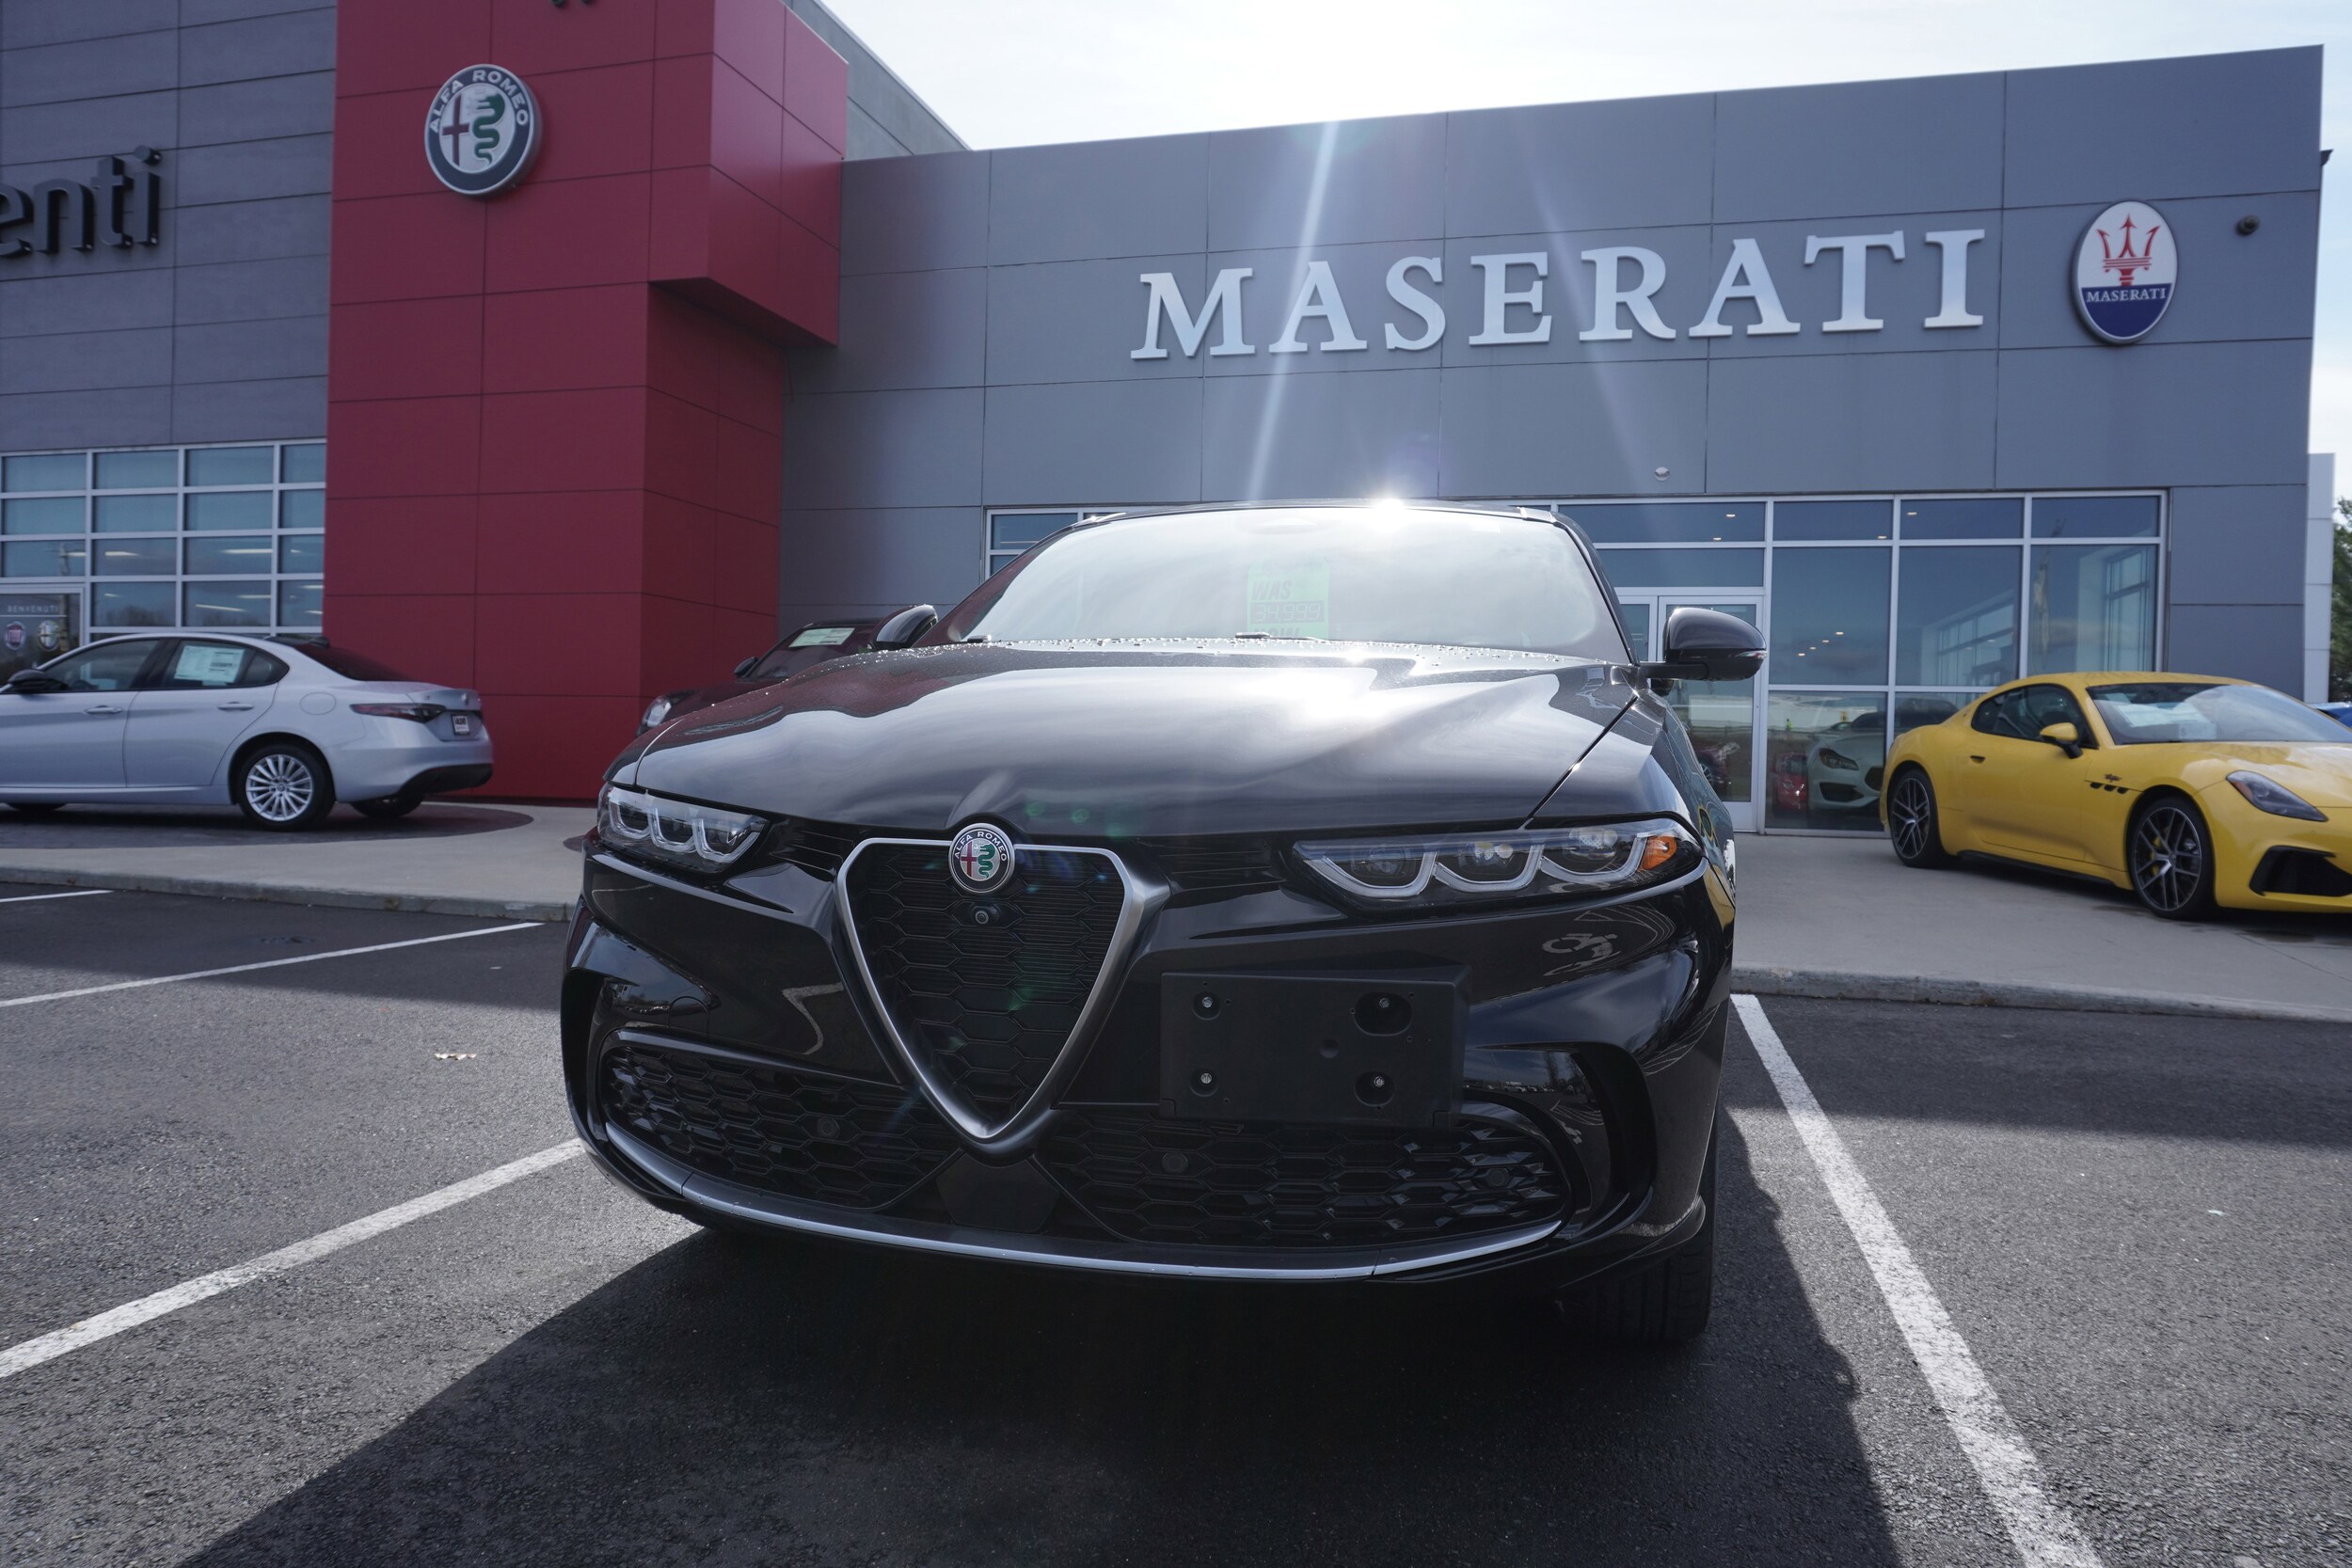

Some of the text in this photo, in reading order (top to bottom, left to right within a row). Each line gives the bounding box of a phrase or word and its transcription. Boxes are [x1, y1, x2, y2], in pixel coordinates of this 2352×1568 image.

[430, 70, 529, 134] ALFA ROMEO
[1131, 229, 1985, 361] MASERATI
[2086, 288, 2167, 303] MASERATI
[1251, 580, 1293, 601] WAS
[954, 831, 1007, 861] ALFA ROMEO
